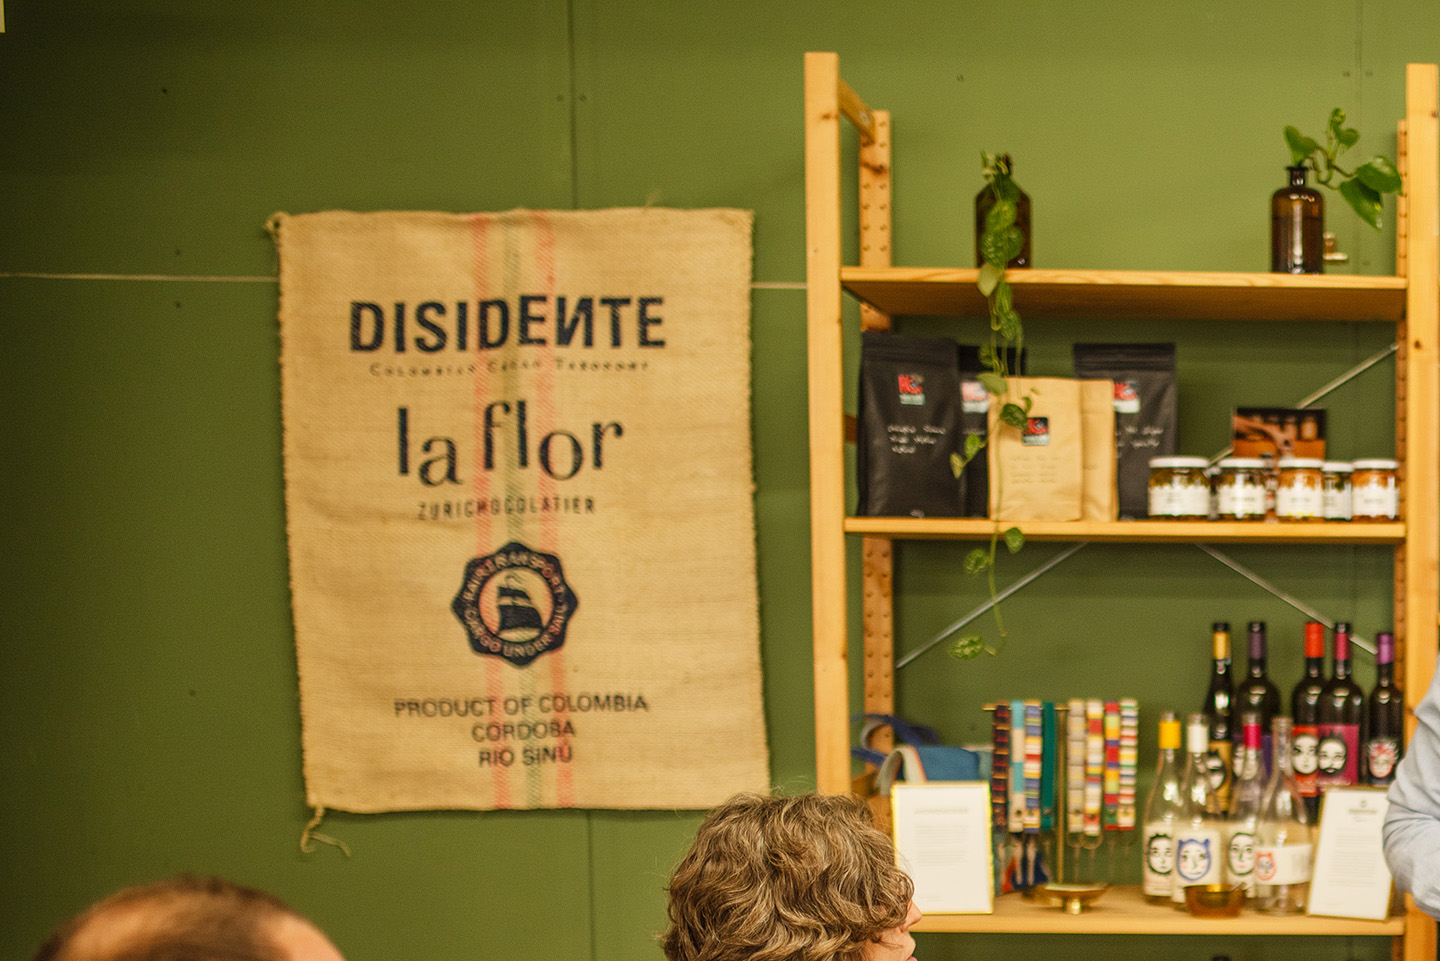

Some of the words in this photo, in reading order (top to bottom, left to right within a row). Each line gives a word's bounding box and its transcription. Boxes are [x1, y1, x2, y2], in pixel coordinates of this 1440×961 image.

[397, 406, 464, 486] la
[484, 400, 625, 481] flor
[394, 698, 495, 717] PRODUCT
[504, 697, 532, 715] OF
[539, 691, 649, 713] COLOMBIA
